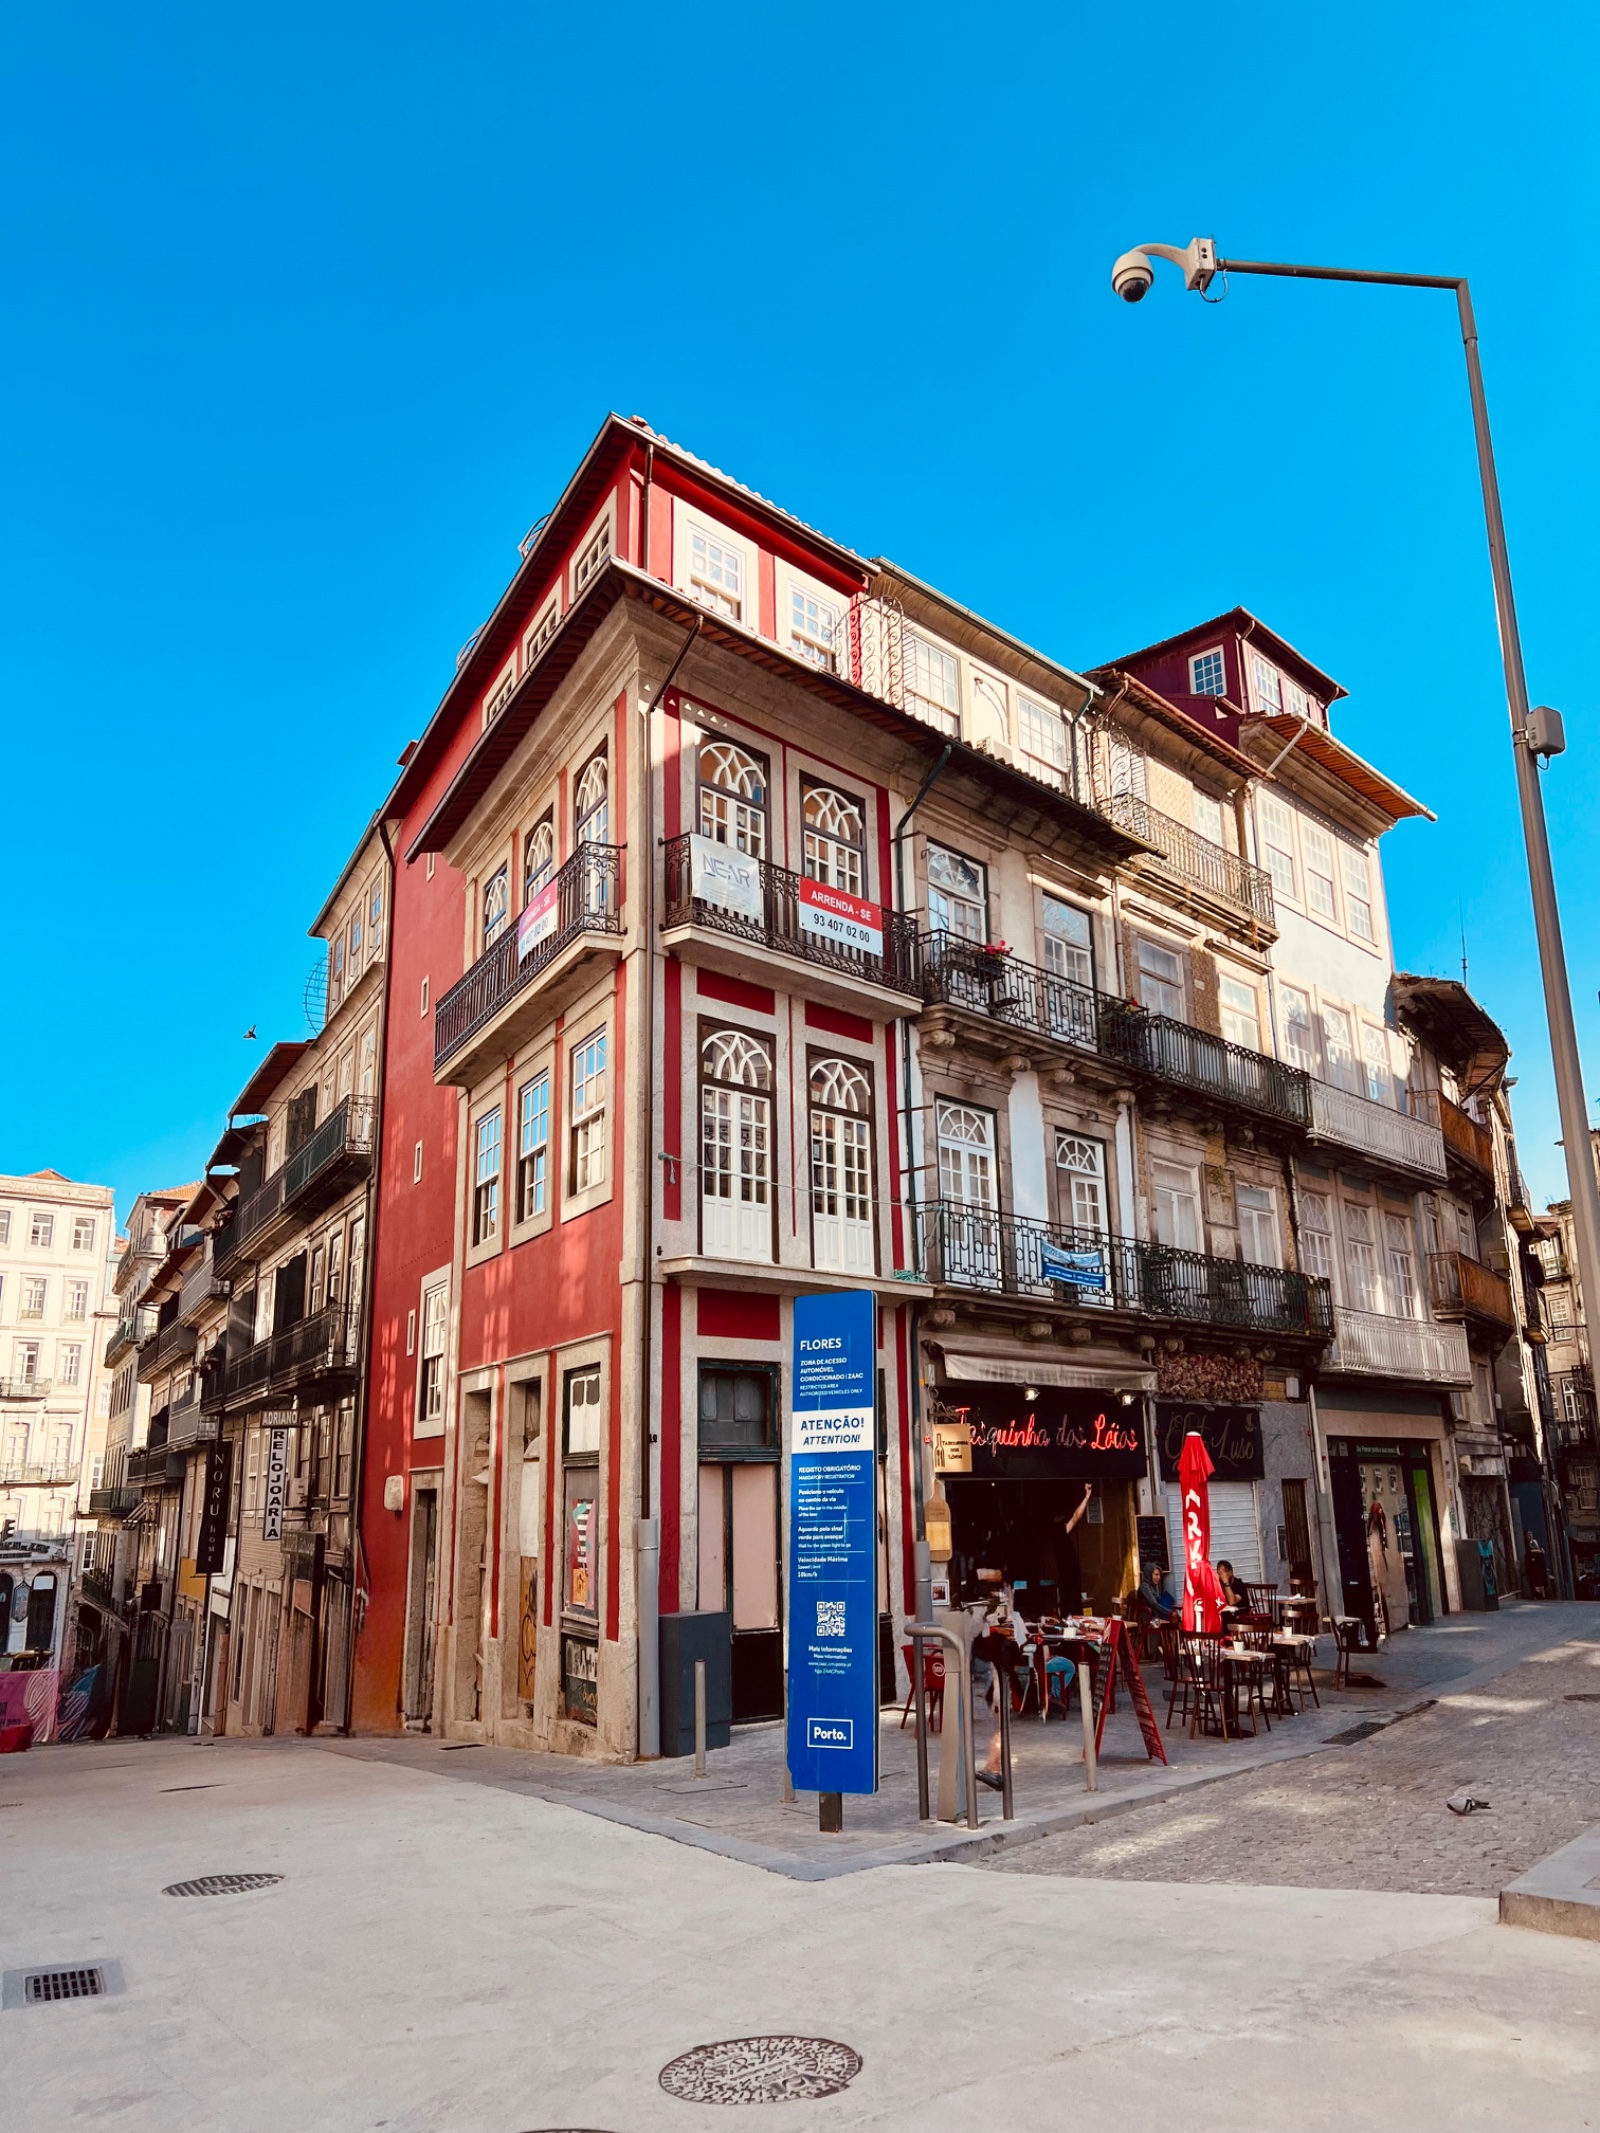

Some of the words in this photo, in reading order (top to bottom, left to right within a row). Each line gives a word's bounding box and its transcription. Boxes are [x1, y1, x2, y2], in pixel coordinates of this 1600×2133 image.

[703, 853, 750, 888] NEAR
[811, 890, 854, 915] ARRENDA
[860, 907, 872, 921] SE
[813, 913, 825, 927] 93
[827, 917, 844, 933] 407
[846, 925, 858, 939] 02
[859, 930, 870, 943] 00
[800, 1338, 842, 1350] FLORES
[824, 1357, 847, 1365] ACESSO
[800, 1366, 834, 1374] AUTOMÓVEL
[800, 1374, 845, 1382] CONDICIONADO
[263, 1411, 298, 1425] ADRIANO
[800, 1415, 864, 1431] ATENÇÃO!
[1056, 1414, 1087, 1449] dos
[803, 1434, 861, 1446] ATTENTION!
[1211, 1419, 1254, 1467] Luso
[798, 1465, 822, 1473] REGISTO
[822, 1464, 861, 1472] OBRIGATÓRIO
[267, 1431, 285, 1538] RELOJOARIA
[813, 1726, 847, 1741] Porto.
